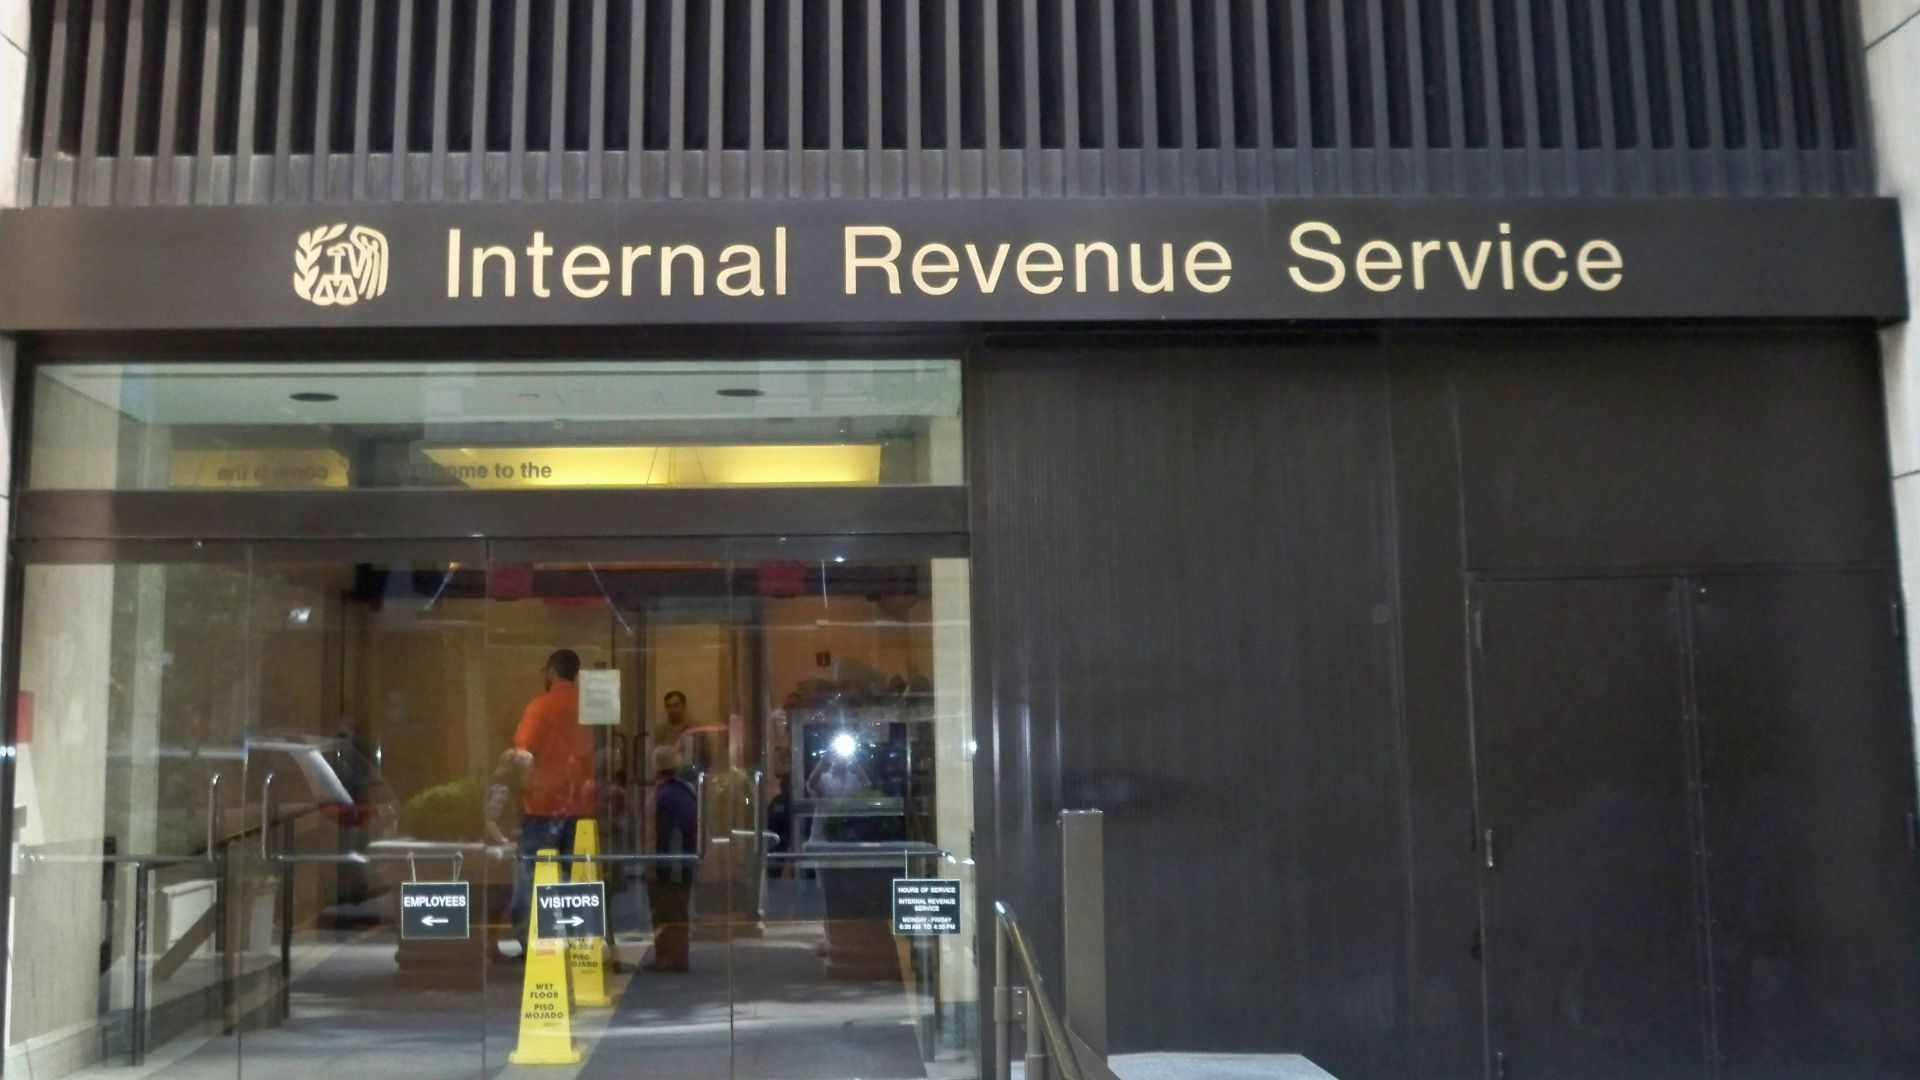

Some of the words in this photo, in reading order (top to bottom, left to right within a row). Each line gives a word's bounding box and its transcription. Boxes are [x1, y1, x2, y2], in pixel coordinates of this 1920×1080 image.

[447, 227, 786, 298] Internal
[844, 225, 1233, 295] Revenue
[1288, 221, 1624, 292] Service
[495, 462, 514, 479] to
[520, 461, 552, 479] the
[404, 895, 466, 908] EMPLOYEES
[540, 895, 600, 909] VISITORS
